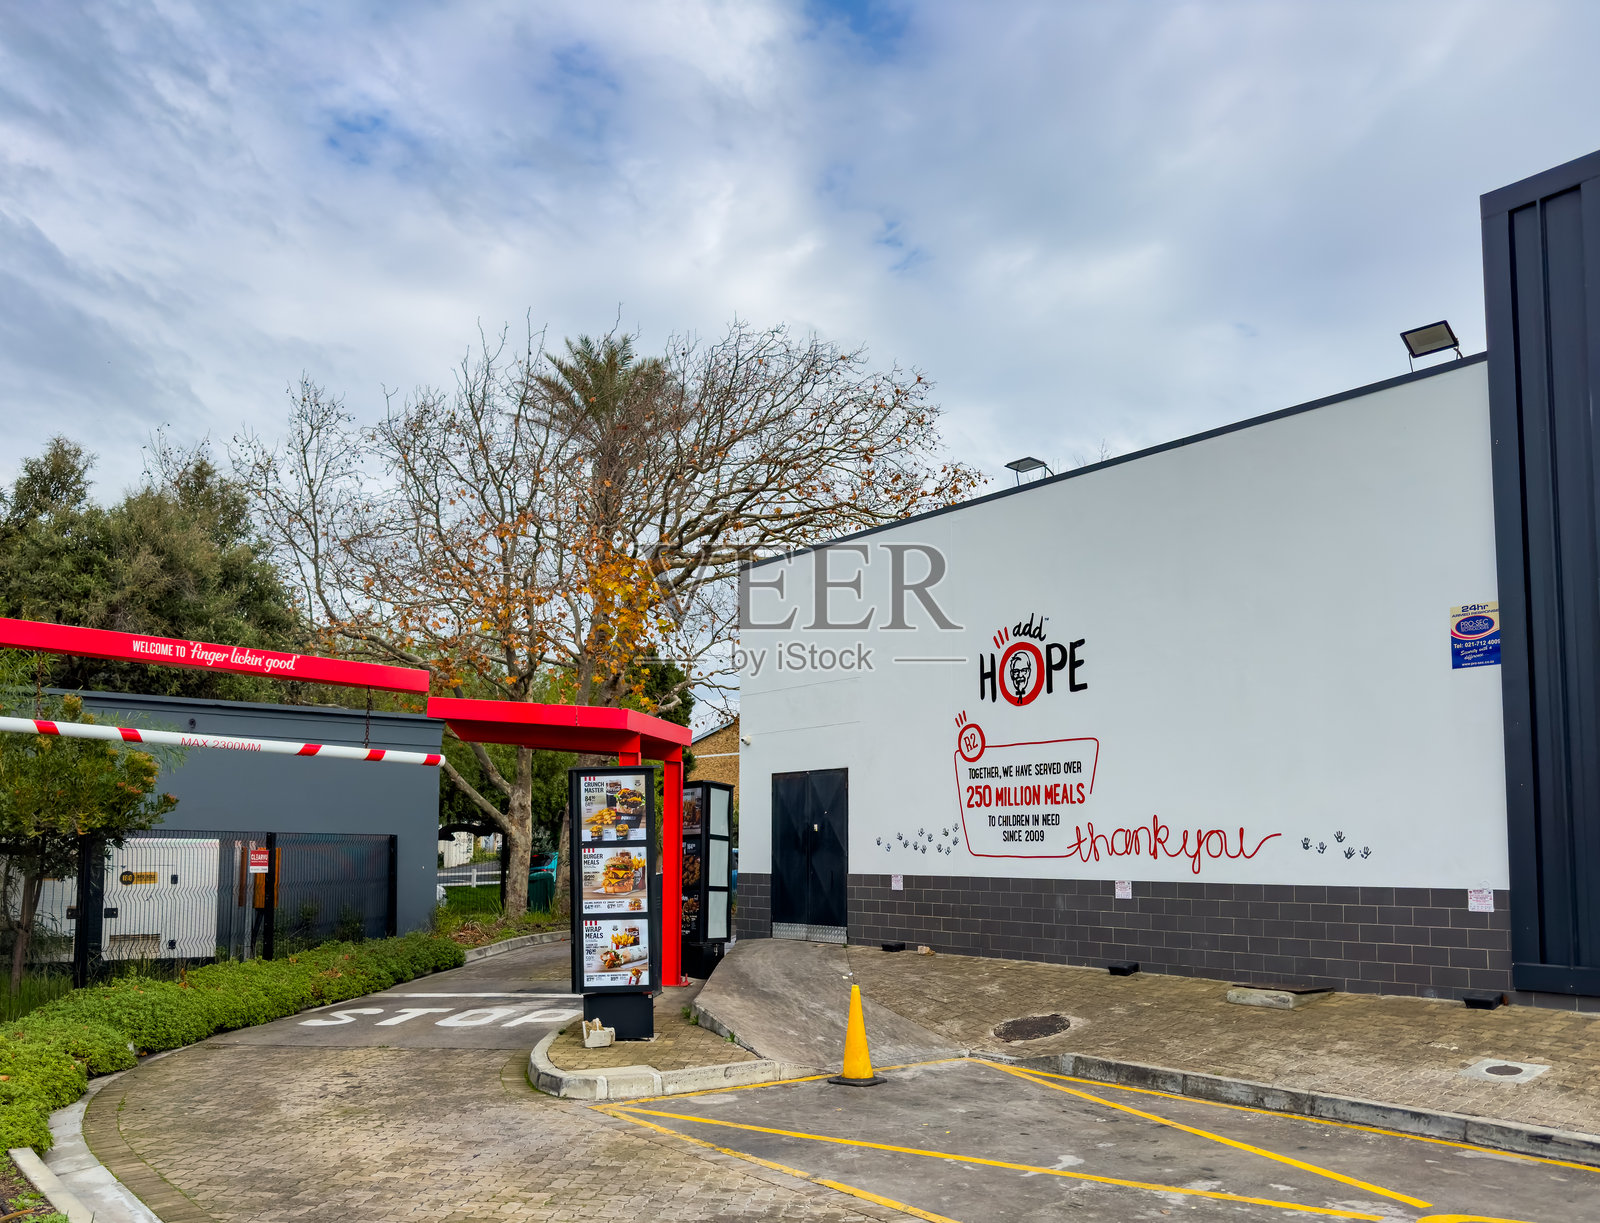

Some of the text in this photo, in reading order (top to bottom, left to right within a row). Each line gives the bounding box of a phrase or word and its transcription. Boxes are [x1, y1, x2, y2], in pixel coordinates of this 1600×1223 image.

[1461, 604, 1489, 613] 24hr
[1012, 612, 1047, 642] add
[132, 640, 174, 657] WELCOME
[175, 645, 186, 658] TO
[230, 647, 265, 667] lickin'
[979, 638, 1088, 707] HOPE
[180, 737, 262, 752] MAX 2300MM
[963, 733, 979, 753] R2
[968, 761, 1082, 780] TOGETHER, WE HAVE SERVED OVER
[966, 782, 1086, 808] 250 MILLION MEALS
[987, 813, 1061, 827] TO CHILDREN IN NEED
[1002, 829, 1045, 843] SINCE 2009
[297, 1007, 584, 1027] STOP
